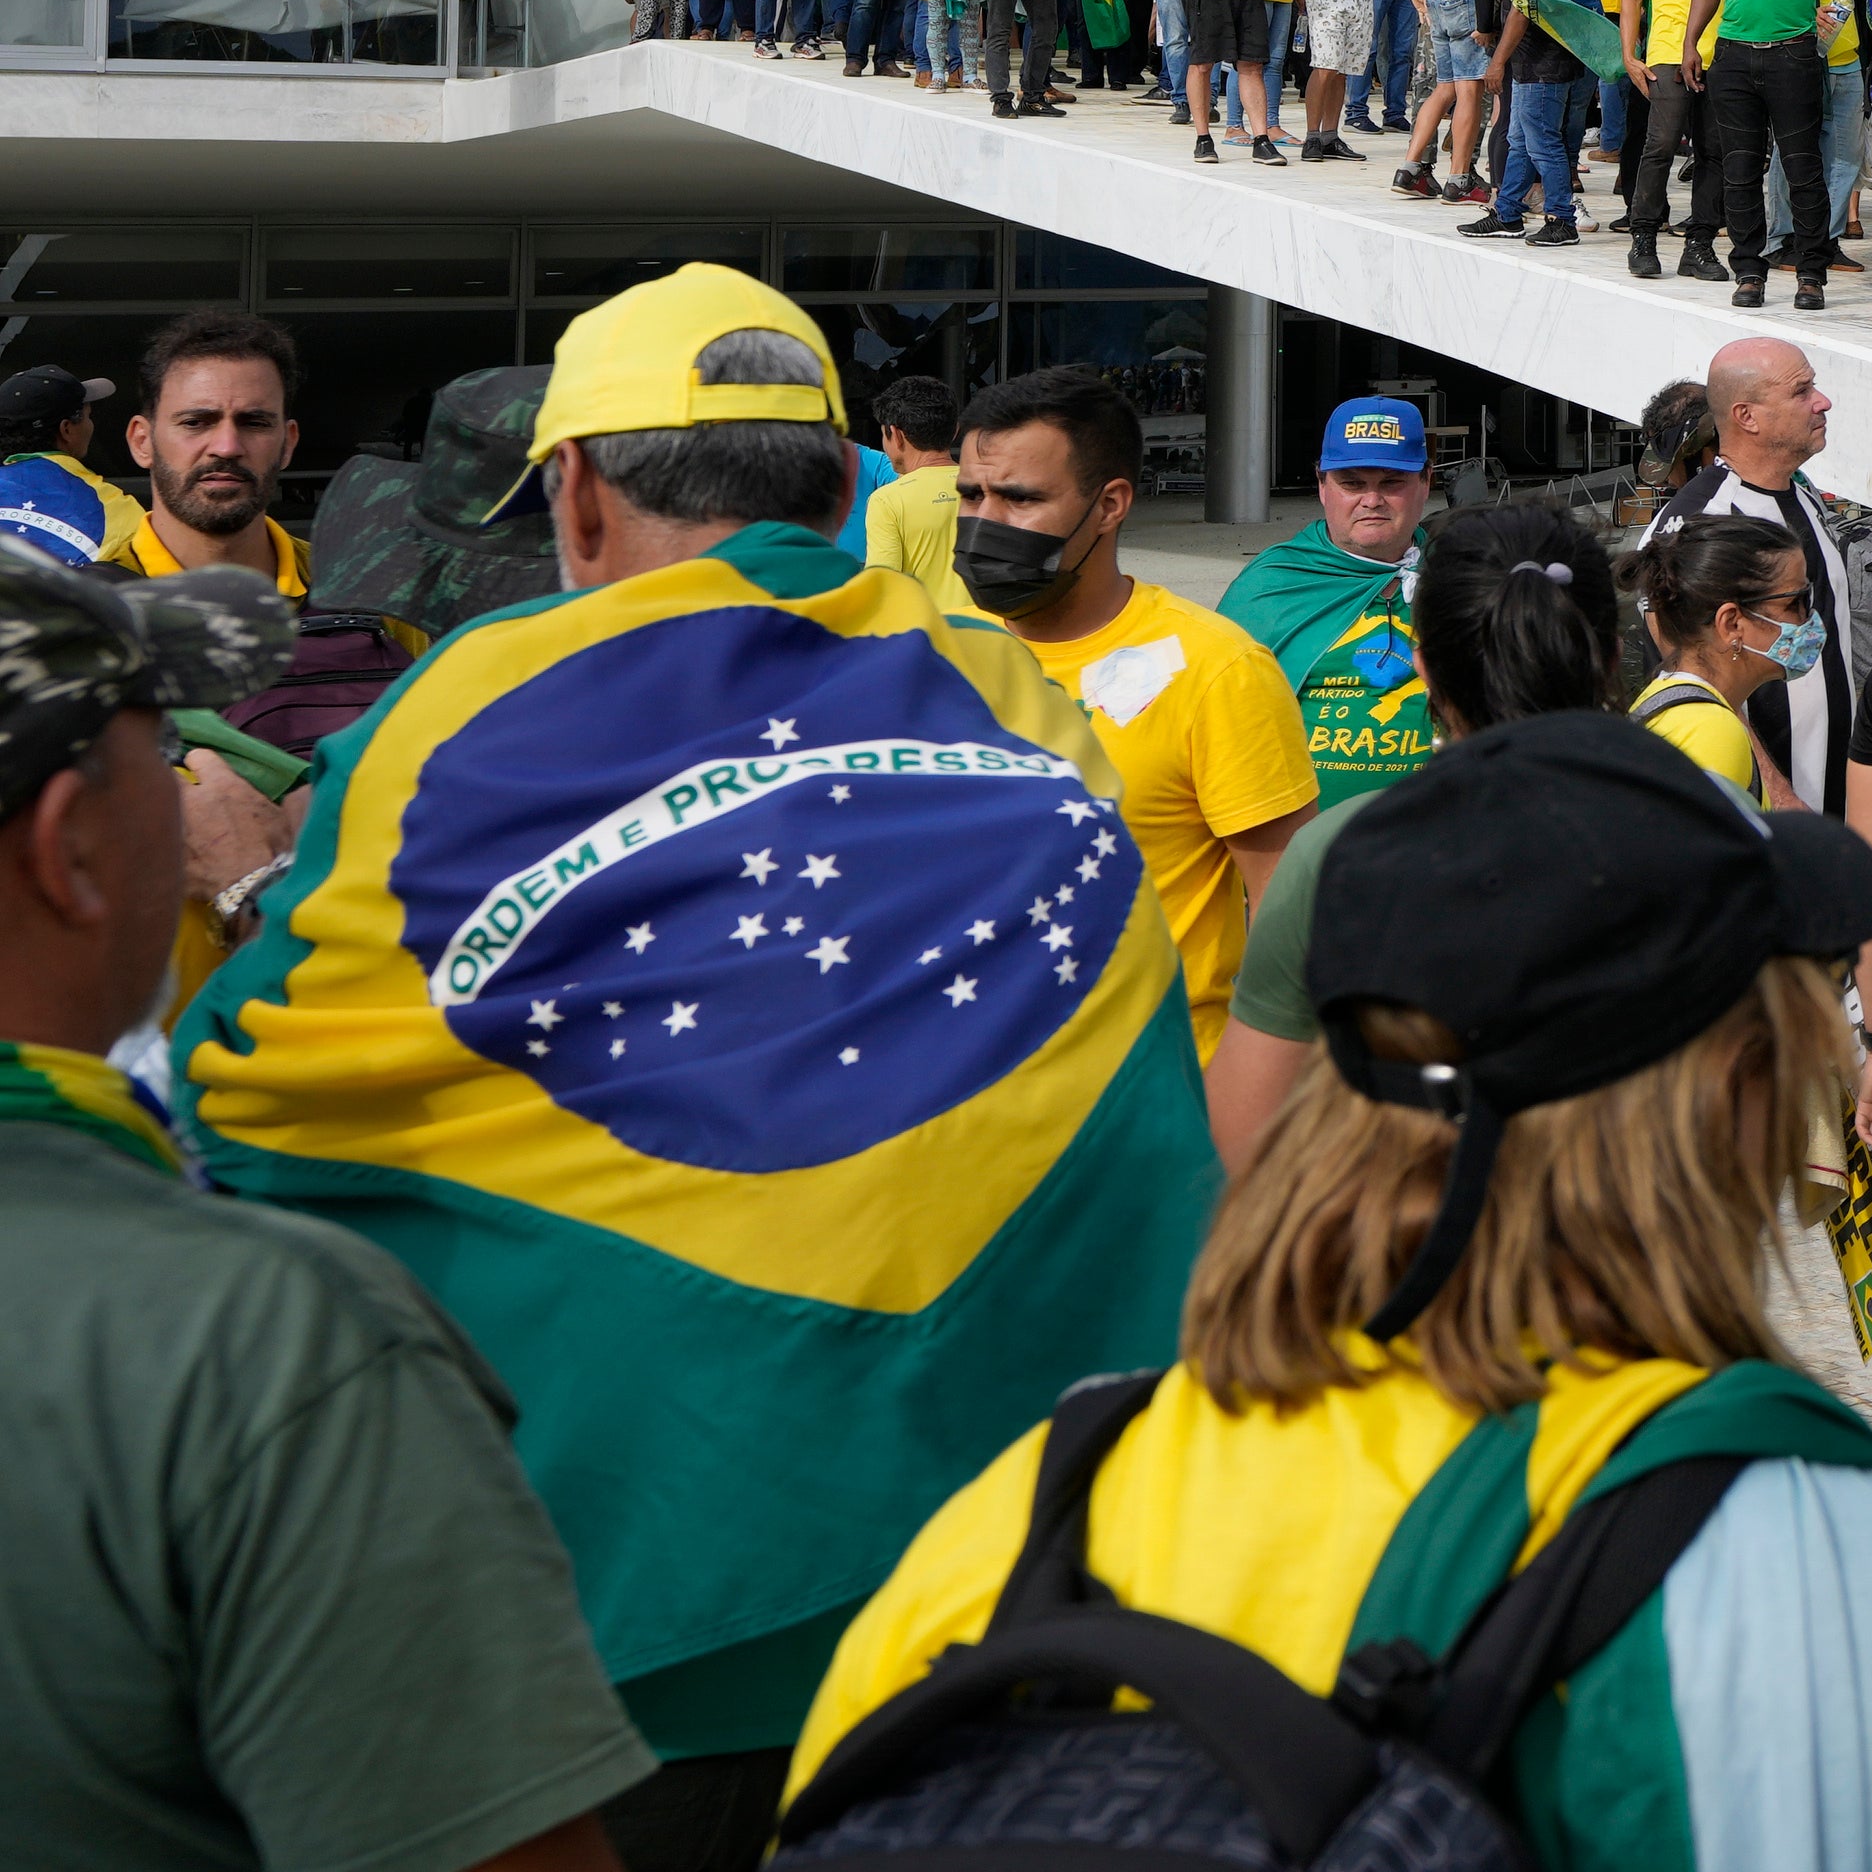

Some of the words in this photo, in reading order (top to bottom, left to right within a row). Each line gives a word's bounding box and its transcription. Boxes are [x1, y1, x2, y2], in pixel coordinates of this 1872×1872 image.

[1344, 421, 1406, 441] BRASIL
[1323, 676, 1360, 686] MEU
[1308, 689, 1365, 699] PARTIDO
[1318, 702, 1331, 719] É
[1335, 705, 1349, 719] O
[1308, 726, 1432, 758] BRASIL
[1367, 763, 1384, 772] DE
[1385, 763, 1408, 772] 2021
[449, 841, 600, 995] ORDEM
[619, 819, 648, 849] E
